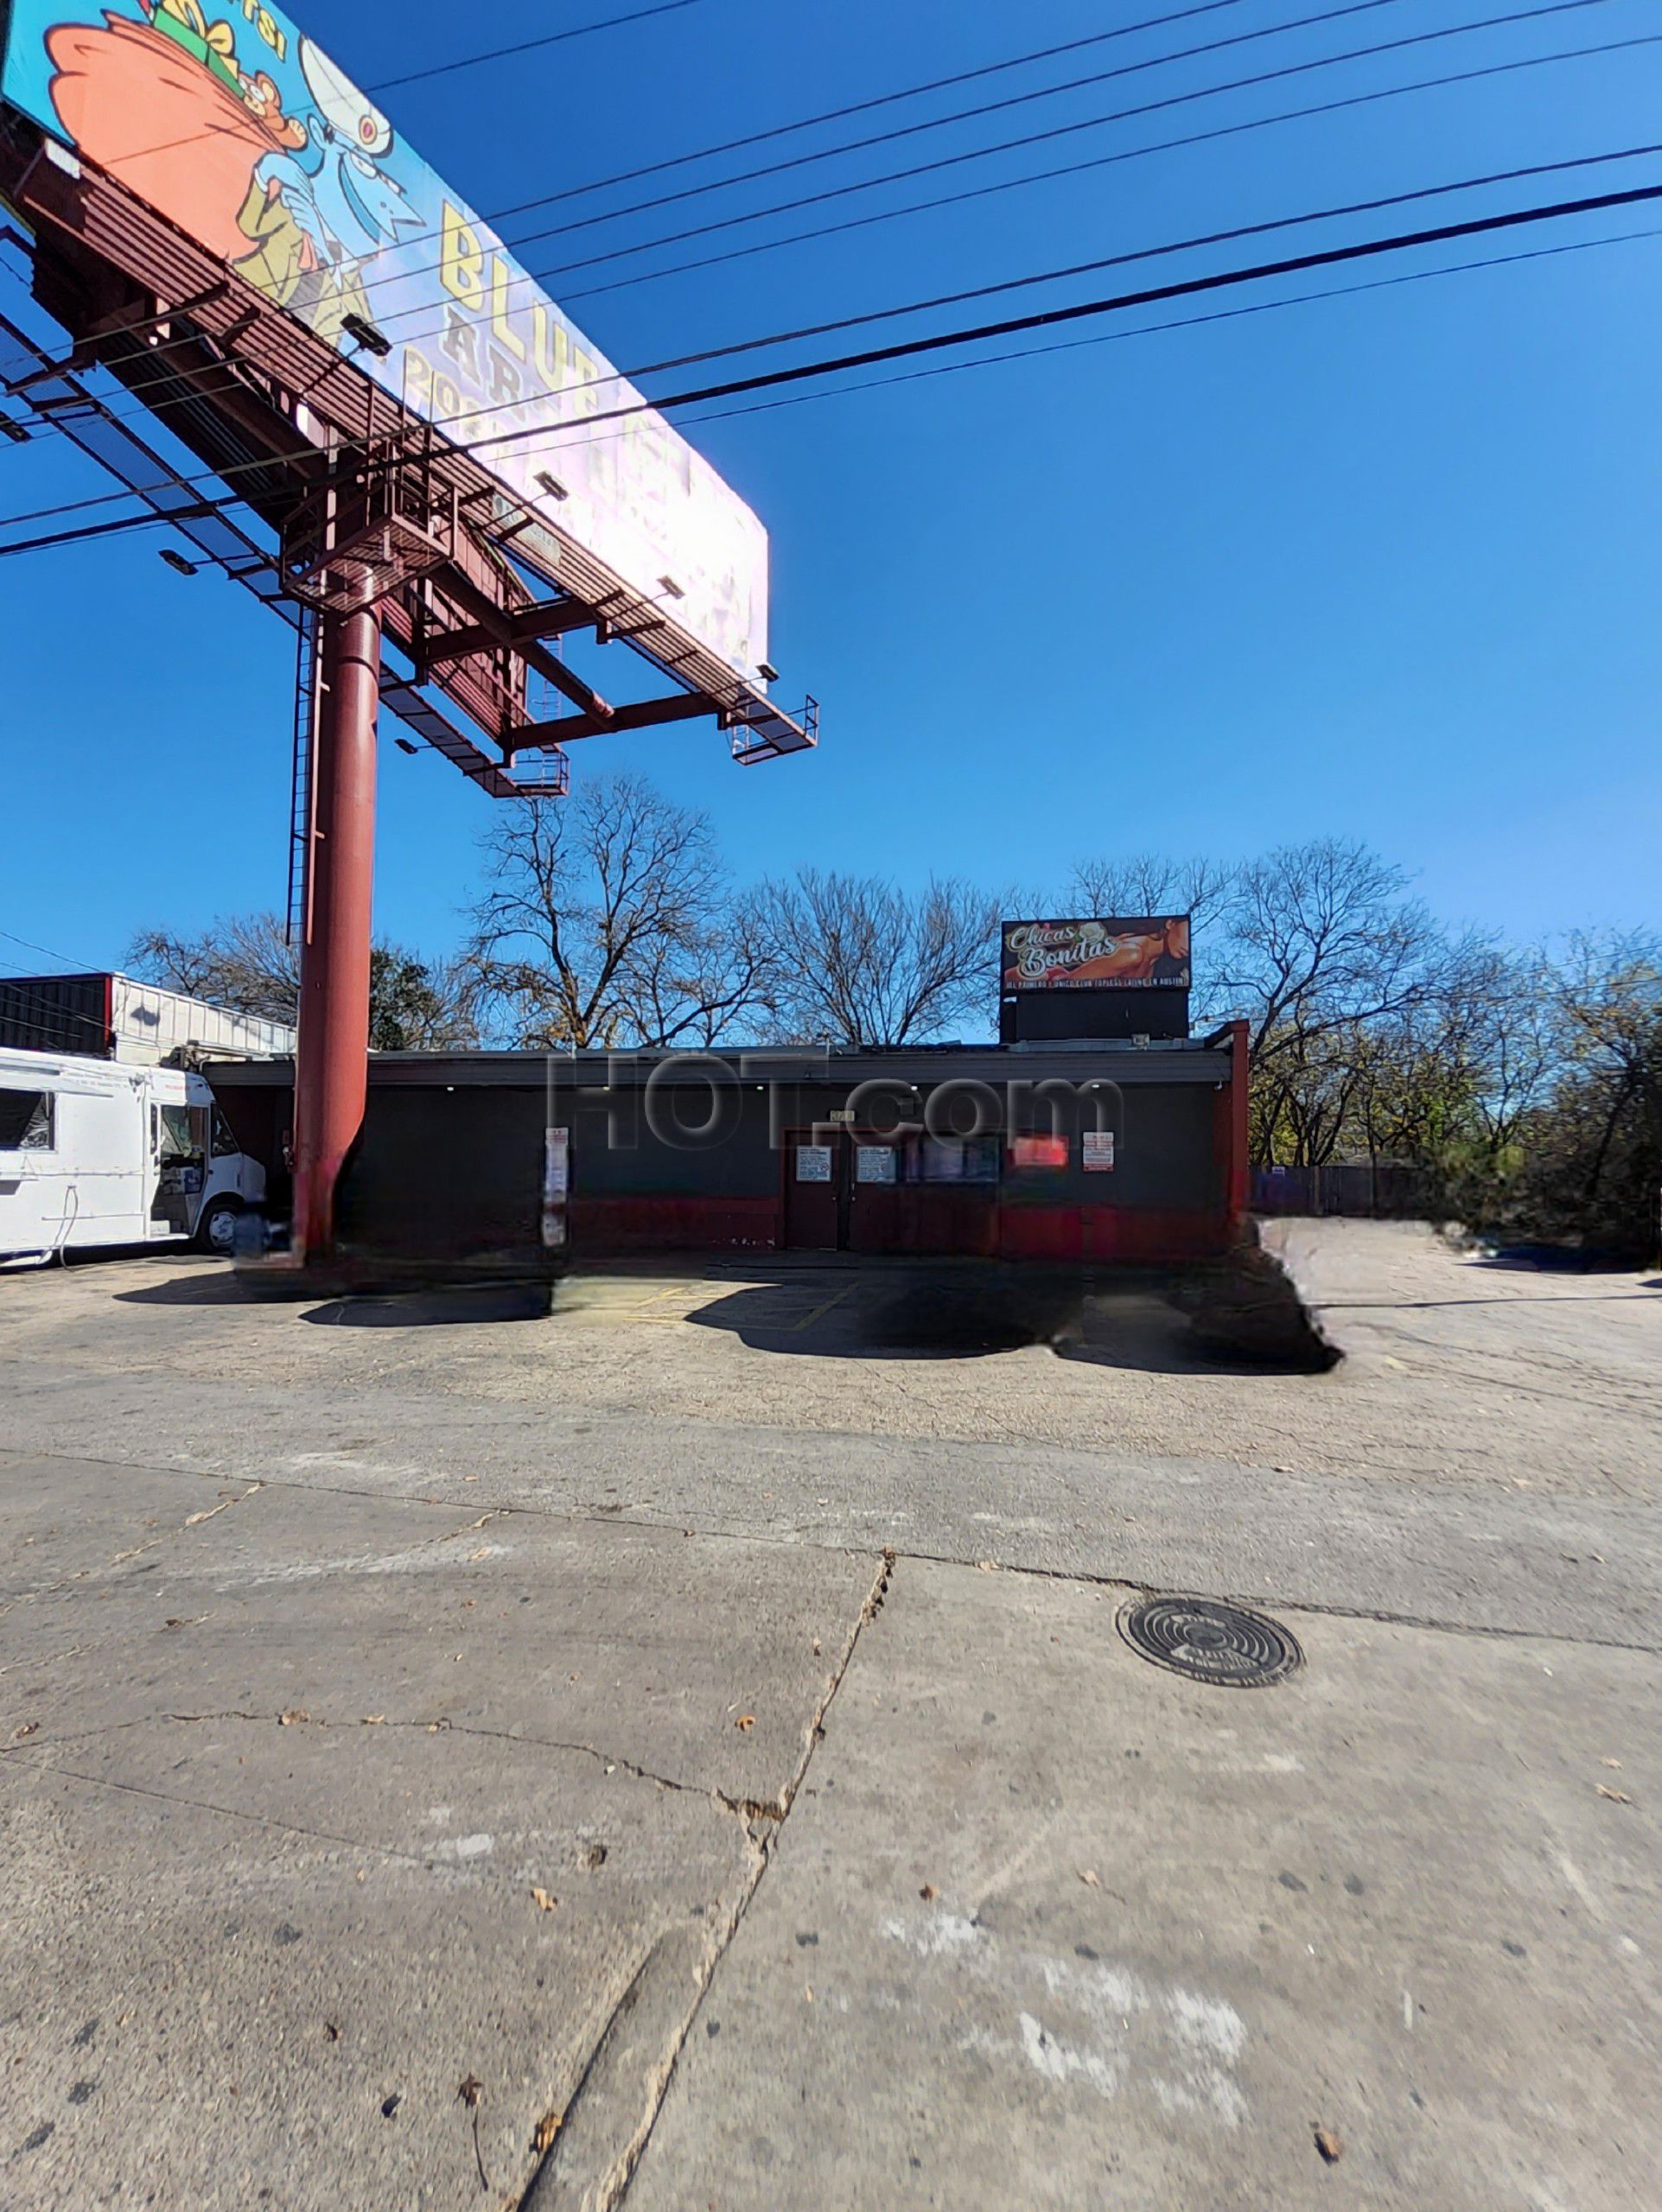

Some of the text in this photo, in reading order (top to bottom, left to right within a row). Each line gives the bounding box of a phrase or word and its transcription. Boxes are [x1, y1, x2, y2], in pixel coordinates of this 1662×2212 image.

[439, 198, 600, 418] BLUE
[1010, 924, 1075, 949] Chicas
[1020, 938, 1118, 976] Bonitas
